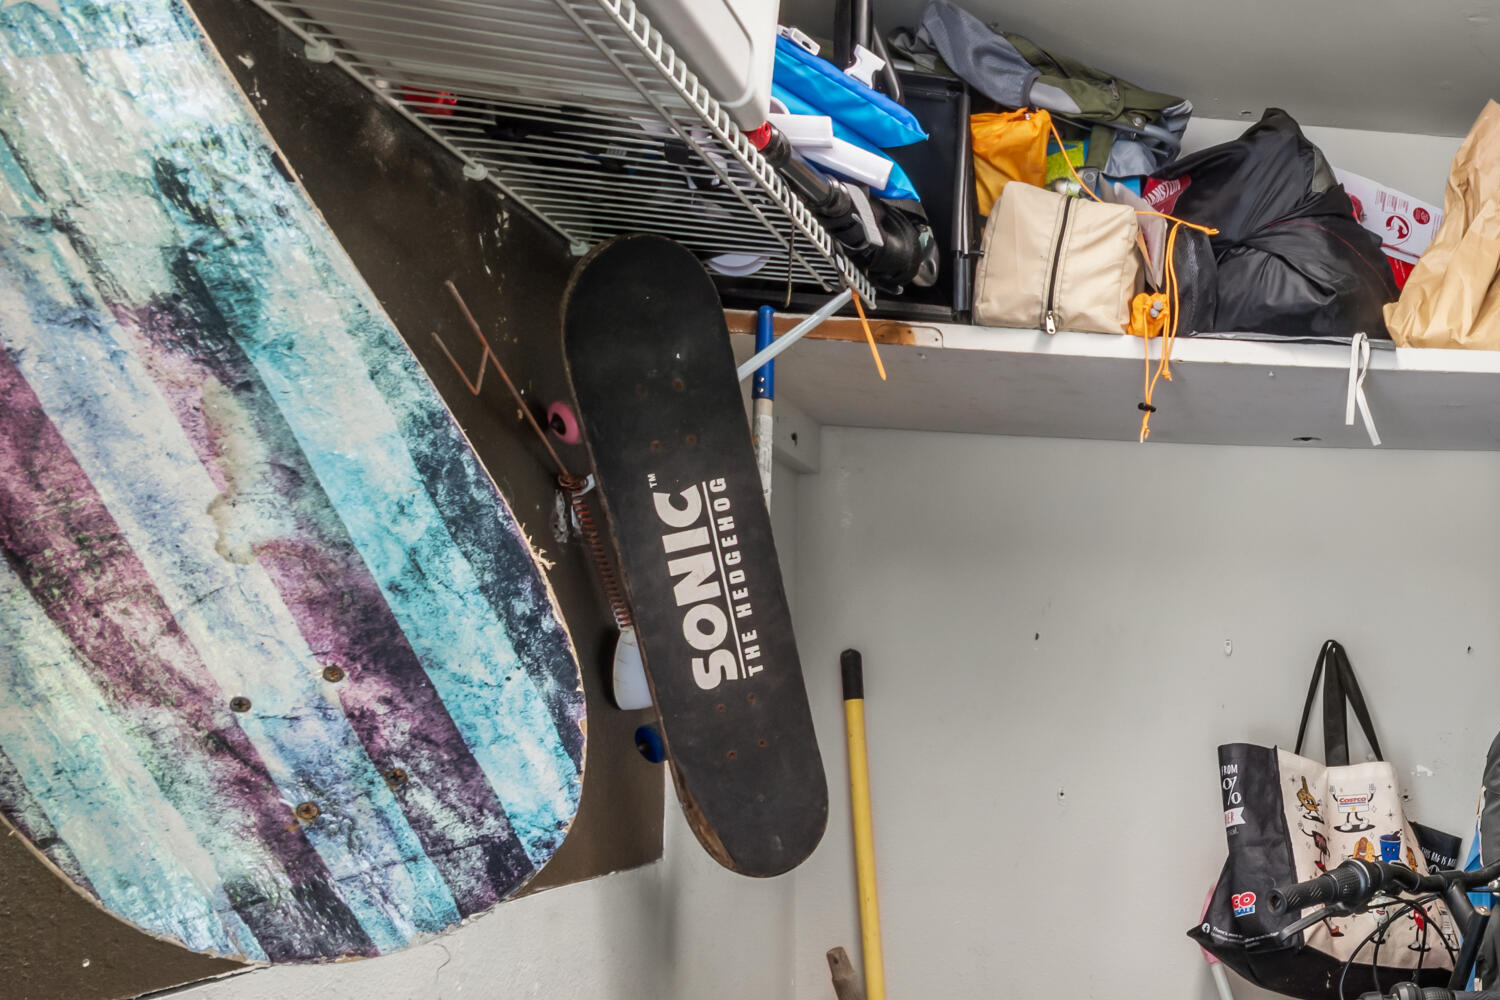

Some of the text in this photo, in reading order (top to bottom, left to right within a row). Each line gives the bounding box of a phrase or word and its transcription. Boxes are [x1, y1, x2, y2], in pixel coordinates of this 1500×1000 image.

[653, 484, 739, 690] SONIC
[709, 477, 764, 677] THE HEDGEHOG
